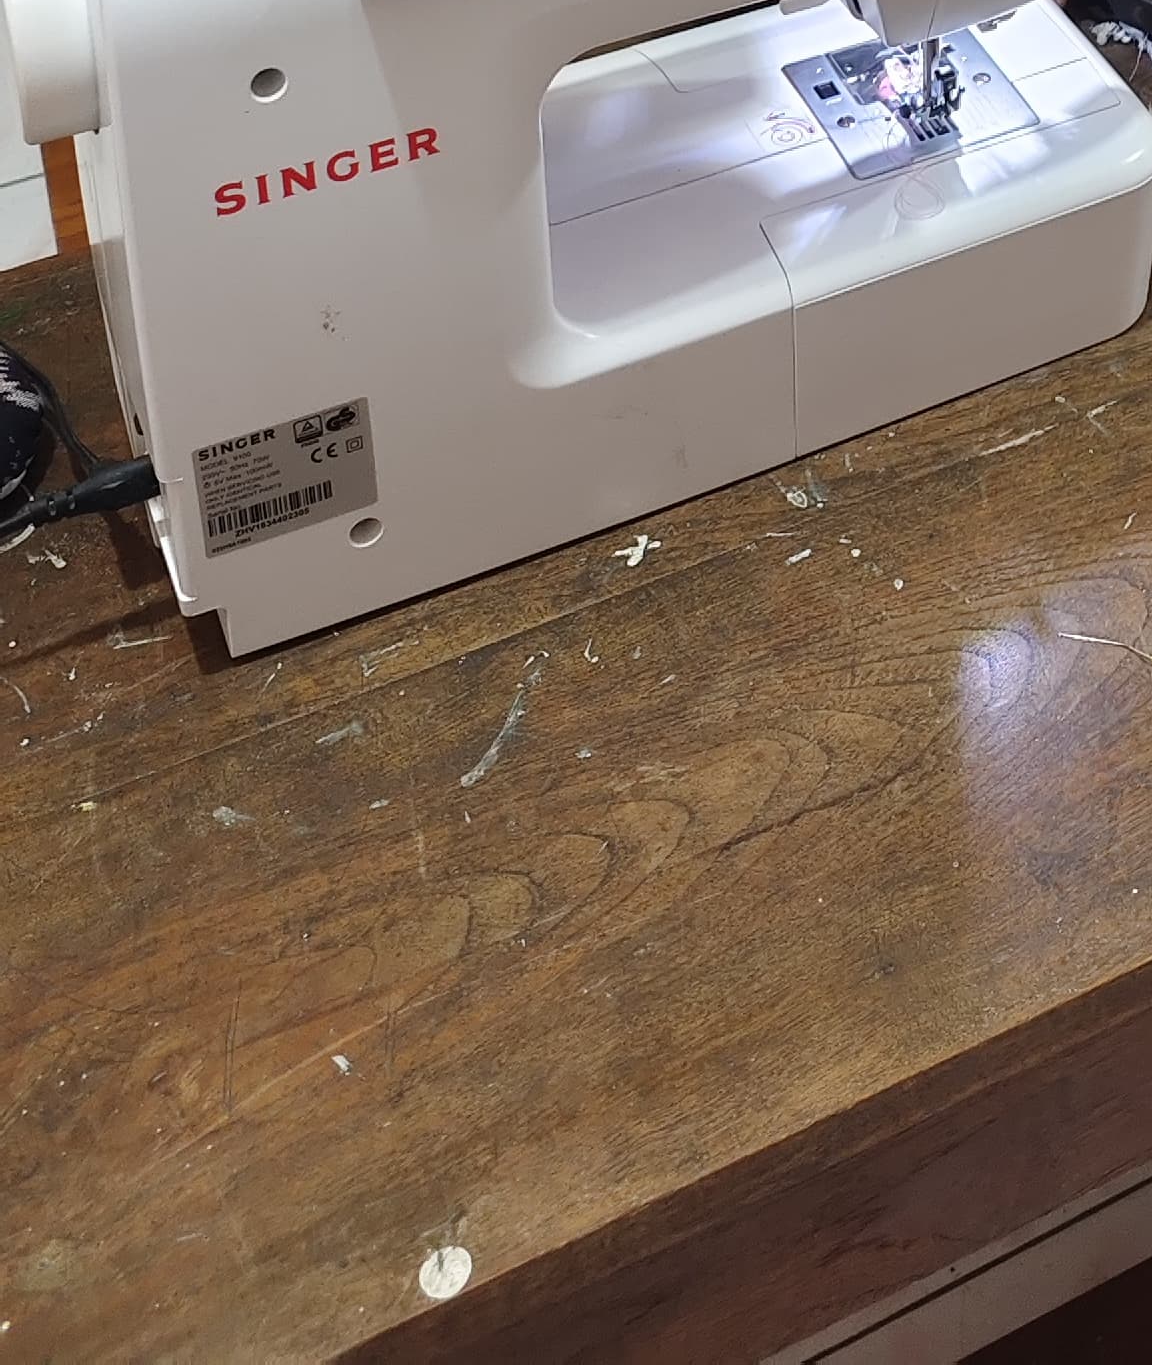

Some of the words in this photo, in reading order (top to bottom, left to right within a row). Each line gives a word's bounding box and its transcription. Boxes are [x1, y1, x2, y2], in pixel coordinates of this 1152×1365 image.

[214, 127, 441, 217] SINGER
[199, 428, 276, 461] SINGER
[200, 460, 227, 472] MODEL
